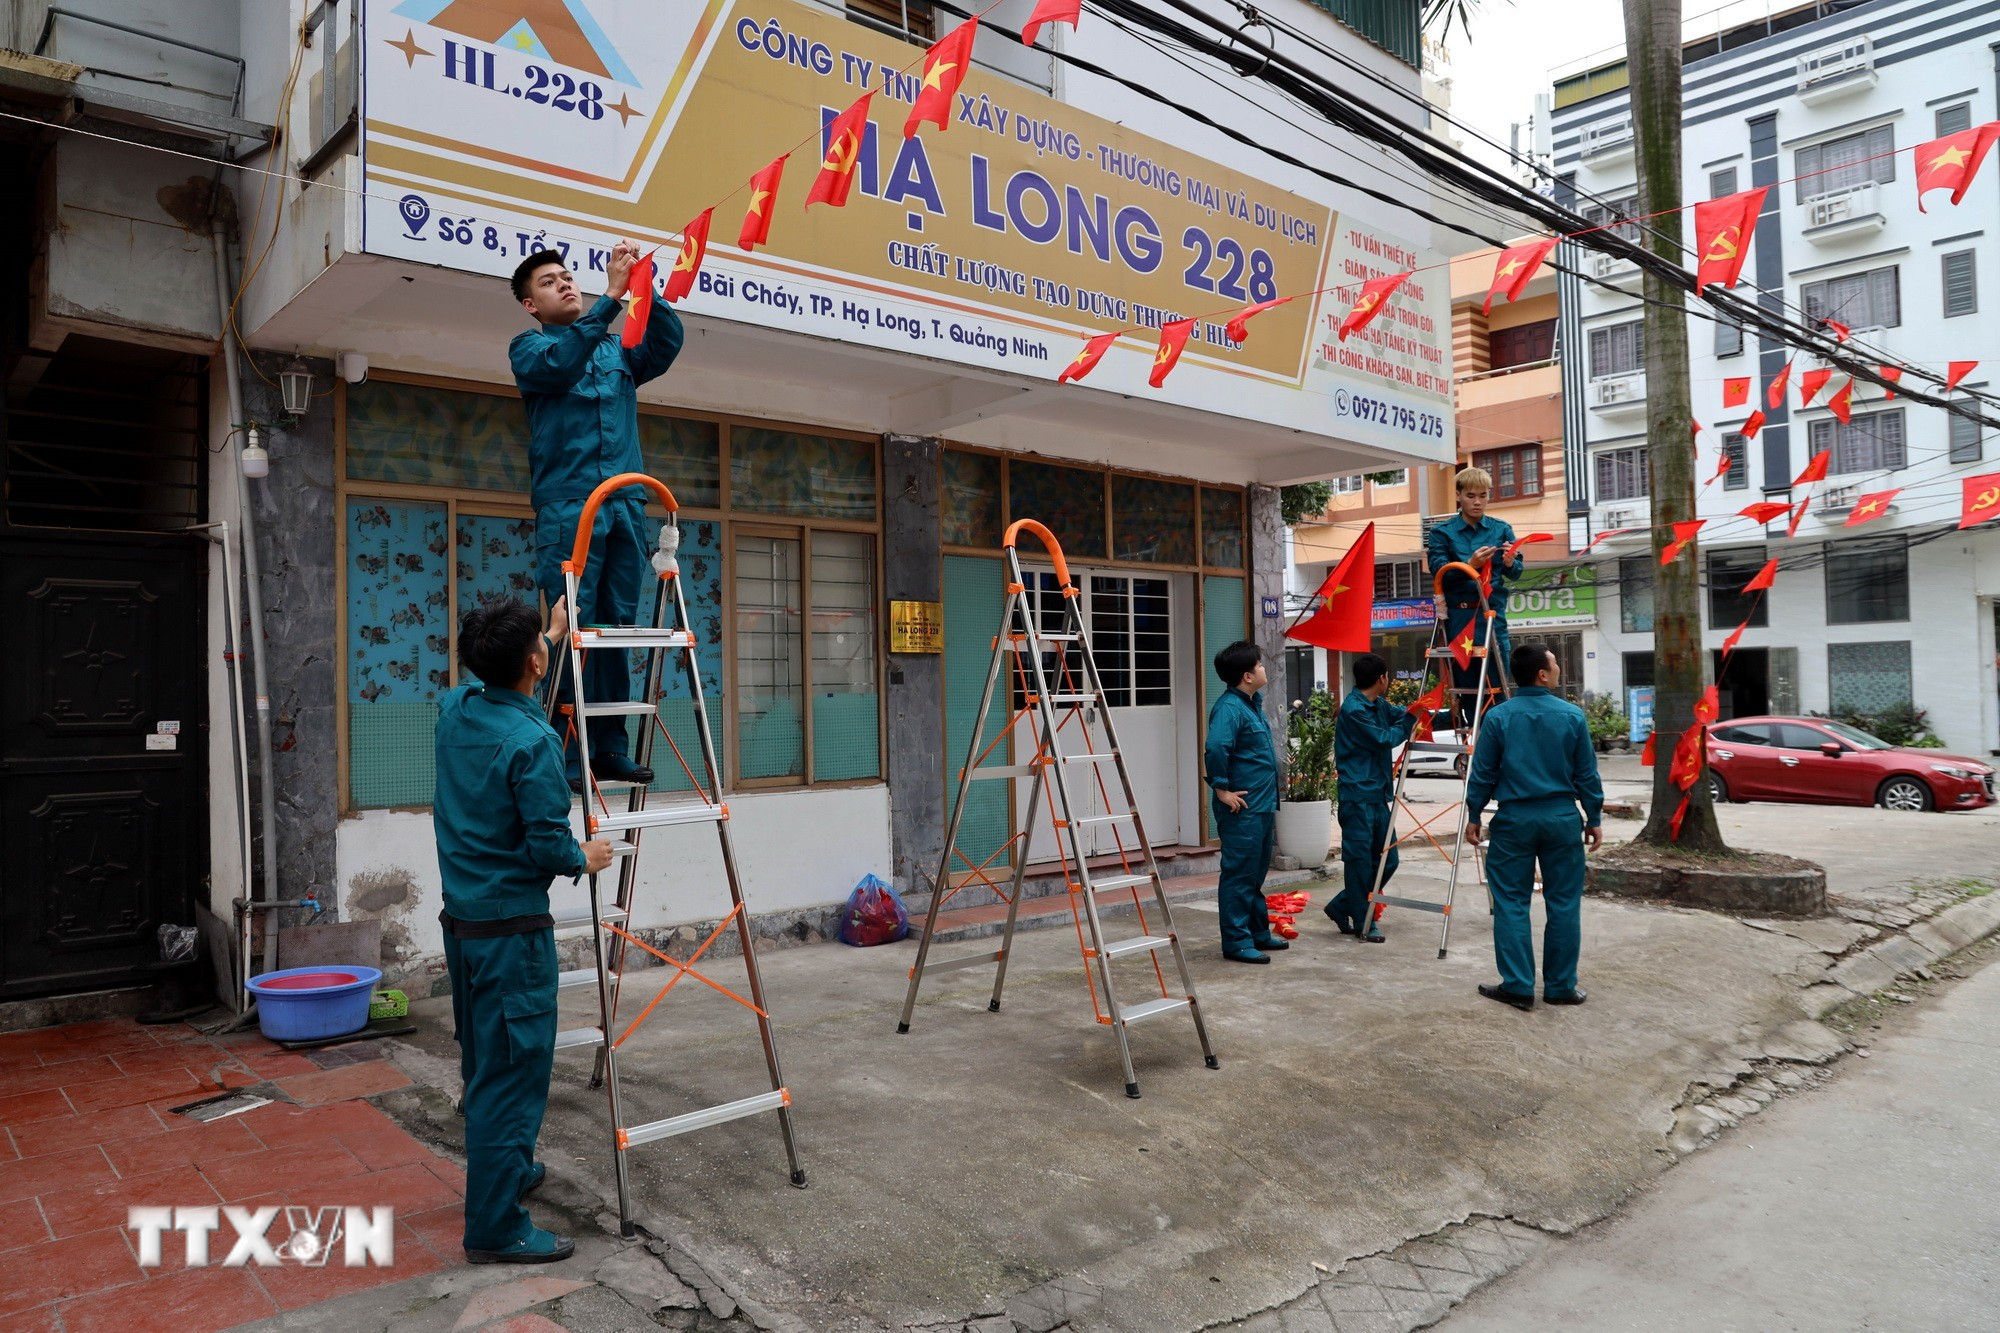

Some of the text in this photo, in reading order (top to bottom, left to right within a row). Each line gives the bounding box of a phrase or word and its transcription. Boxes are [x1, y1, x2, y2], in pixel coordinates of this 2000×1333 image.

[442, 39, 604, 120] HL.228
[737, 18, 832, 75] CÔNG
[841, 52, 873, 89] TY
[881, 65, 921, 104] TN
[958, 94, 1008, 135] XÂY
[1016, 115, 1081, 160] DỰNG
[1098, 144, 1181, 196] THƯƠNG
[1187, 177, 1220, 215] MẠI
[1226, 190, 1250, 222] VÀ
[1255, 203, 1277, 232] DU
[1282, 215, 1317, 246] LỊCH
[971, 153, 1163, 274] LONG
[1182, 227, 1277, 307] 228
[1350, 231, 1362, 248] TƯ
[1364, 234, 1380, 256] VẤN
[1383, 244, 1404, 265] THIẾT
[1407, 252, 1416, 269] KẾ
[439, 217, 475, 245] Số
[483, 227, 506, 257] 8,
[517, 230, 547, 256] Tổ
[557, 242, 578, 271] 7,
[700, 271, 733, 298] Bãi
[742, 280, 803, 315] Cháy,
[810, 294, 834, 317] TP.
[842, 302, 869, 329] Hạ
[877, 307, 926, 339] Long,
[932, 319, 943, 339] T.
[950, 324, 1007, 357] Quảng
[1013, 337, 1048, 361] Ninh
[889, 241, 948, 277] CHẤT
[956, 257, 1025, 296] LƯỢNG
[1033, 277, 1071, 308] TẠO
[1076, 288, 1127, 321] DỰNG
[1132, 304, 1200, 339] THƯG
[1345, 259, 1368, 280] GIÁM
[1403, 280, 1424, 302] CÔNG
[1336, 286, 1350, 305] THI
[1398, 308, 1418, 329] TRỌN
[1421, 315, 1433, 334] GÓI
[1371, 328, 1382, 349] HẠ
[1419, 344, 1442, 366] THUẬT
[1322, 344, 1336, 362] THI
[1339, 347, 1363, 369] CÔNG
[1366, 357, 1394, 379] KHÁCH
[1396, 365, 1414, 386] SẠN,
[1417, 371, 1432, 392] BIỆT
[1435, 377, 1449, 398] THỰ
[1352, 395, 1443, 438] 0972 795 275
[1265, 601, 1277, 614] 08
[1505, 587, 1576, 613] oora
[910, 627, 928, 635] LONG
